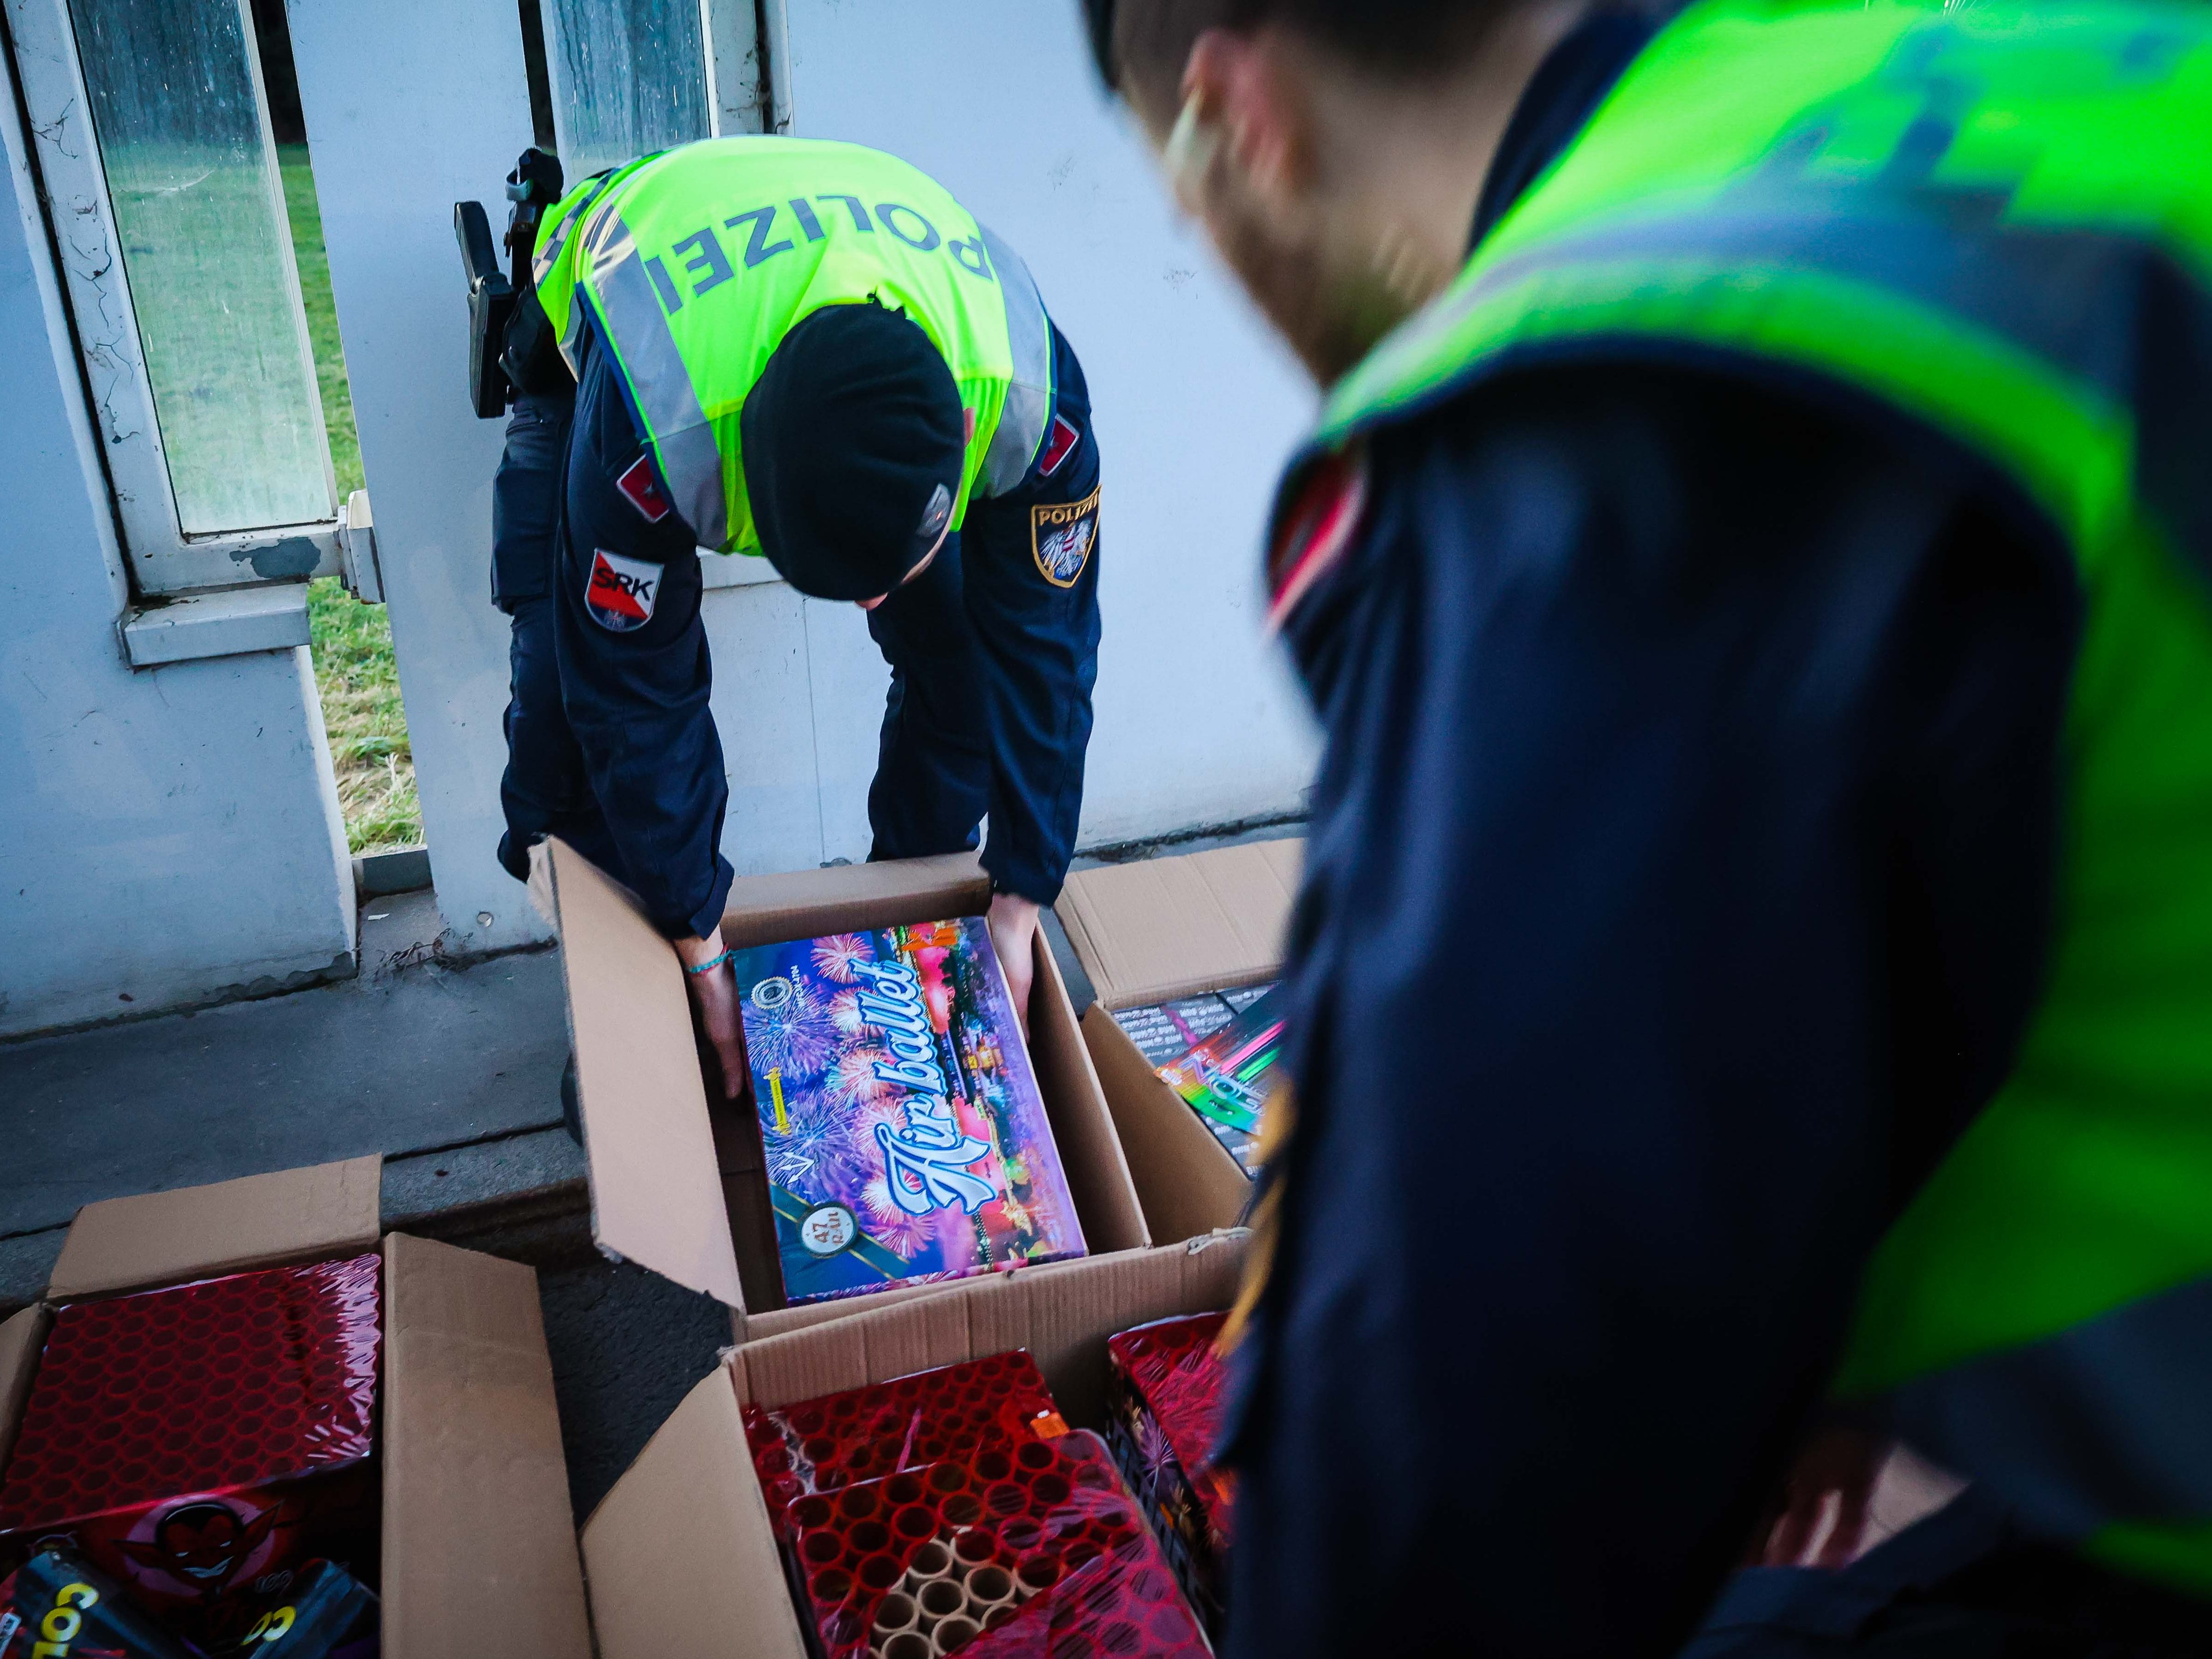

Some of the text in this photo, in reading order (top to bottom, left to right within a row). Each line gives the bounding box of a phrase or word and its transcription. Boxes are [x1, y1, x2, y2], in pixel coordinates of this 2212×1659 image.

[645, 195, 994, 316] POLIZEI
[1039, 492, 1098, 526] POLIZEI
[594, 567, 653, 601] SRK
[850, 959, 997, 1215] Air ballet
[813, 1223, 829, 1243] 47
